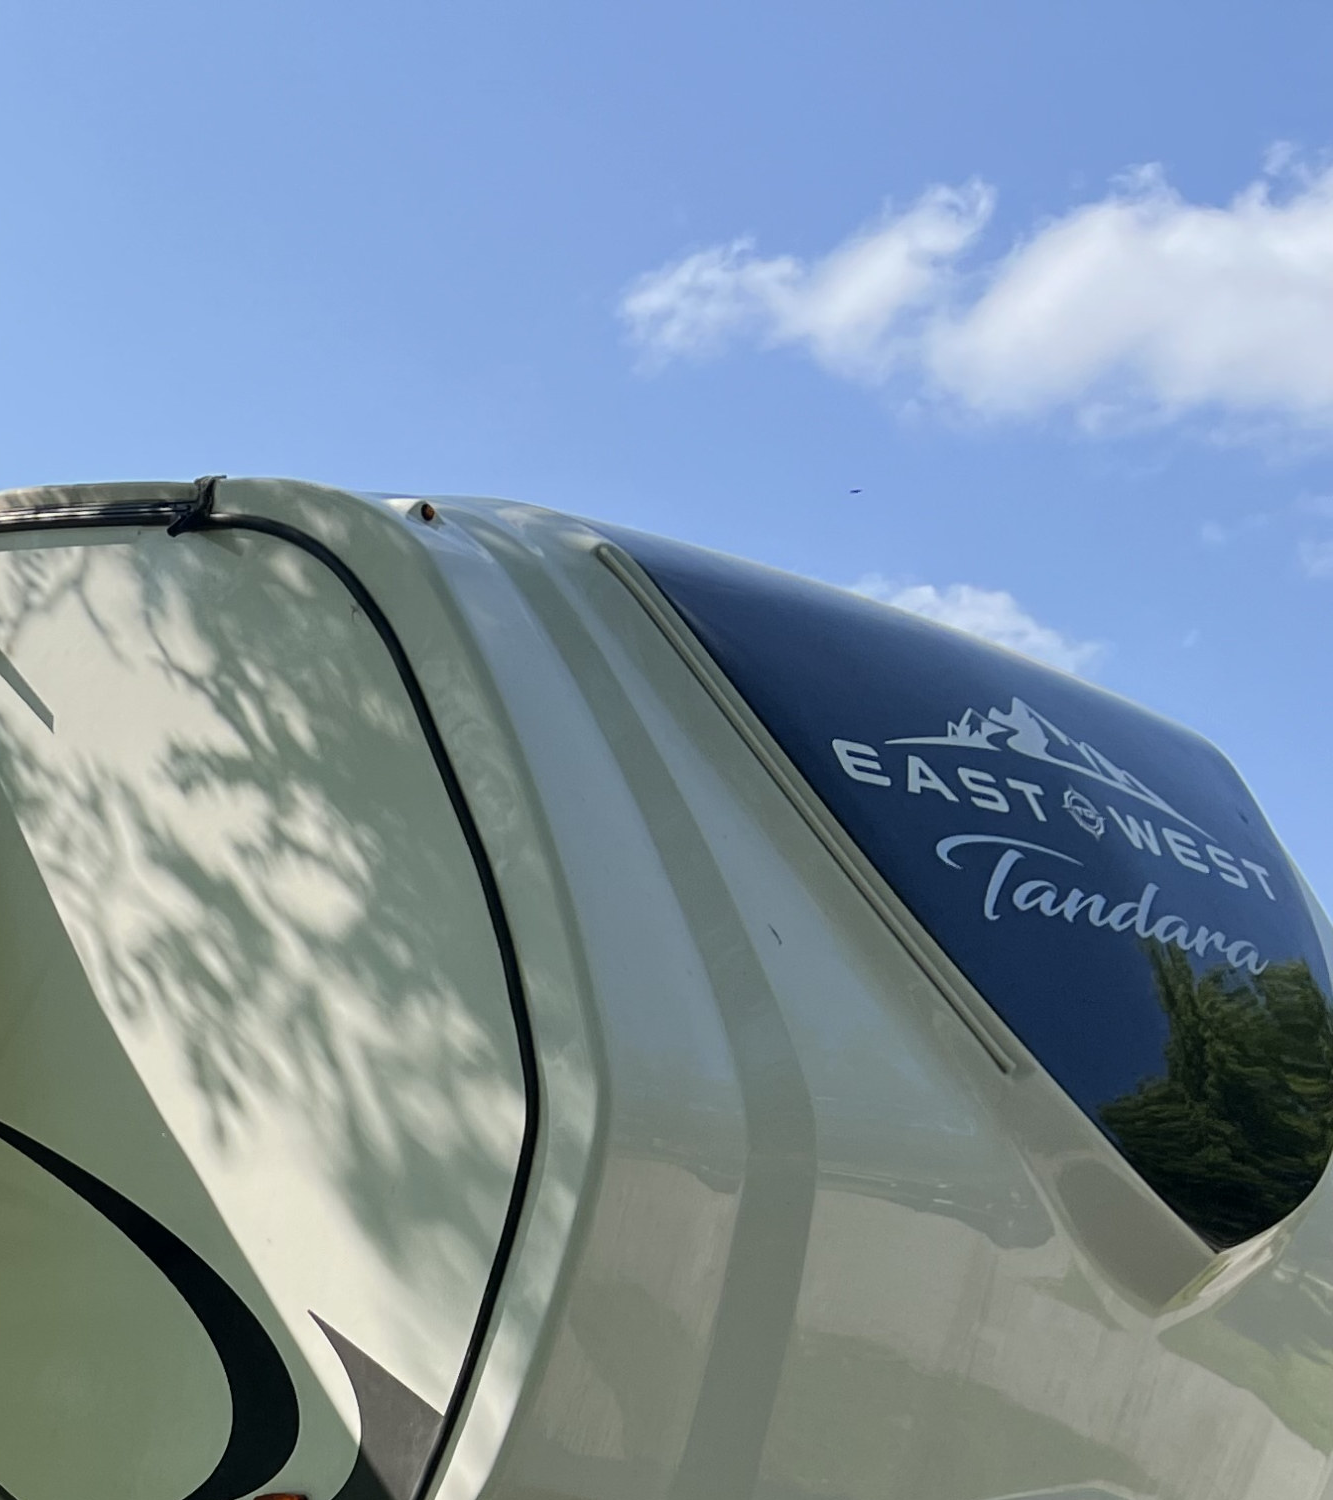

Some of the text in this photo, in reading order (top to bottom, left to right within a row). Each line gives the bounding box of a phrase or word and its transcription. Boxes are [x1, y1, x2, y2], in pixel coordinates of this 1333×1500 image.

[833, 738, 1277, 901] EAST WEST
[935, 833, 1270, 975] Tandara
